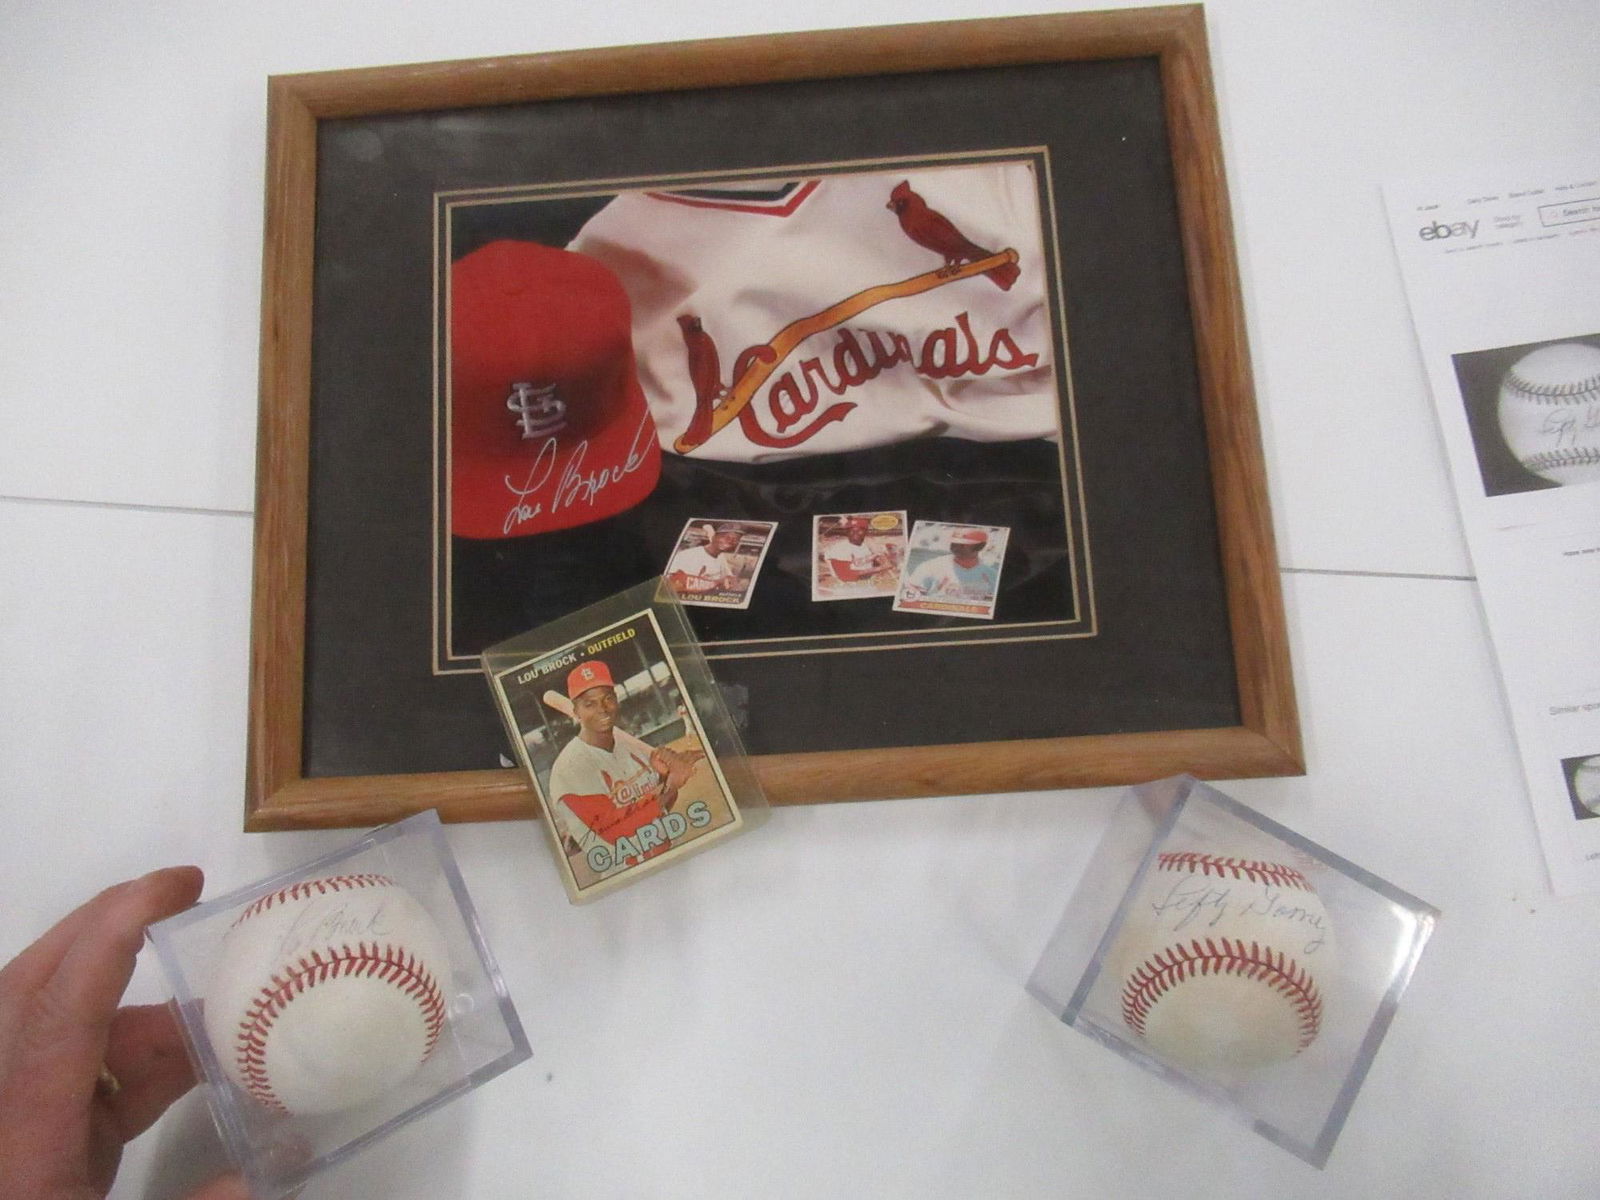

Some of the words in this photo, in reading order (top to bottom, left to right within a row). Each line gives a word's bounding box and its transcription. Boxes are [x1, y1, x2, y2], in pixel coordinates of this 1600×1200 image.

[1419, 220, 1480, 241] ebay
[732, 312, 1039, 449] Cardinals
[517, 669, 539, 685] LOU
[541, 652, 577, 676] BROCK
[587, 628, 636, 656] OUTFIELD
[586, 800, 712, 873] CARDS
